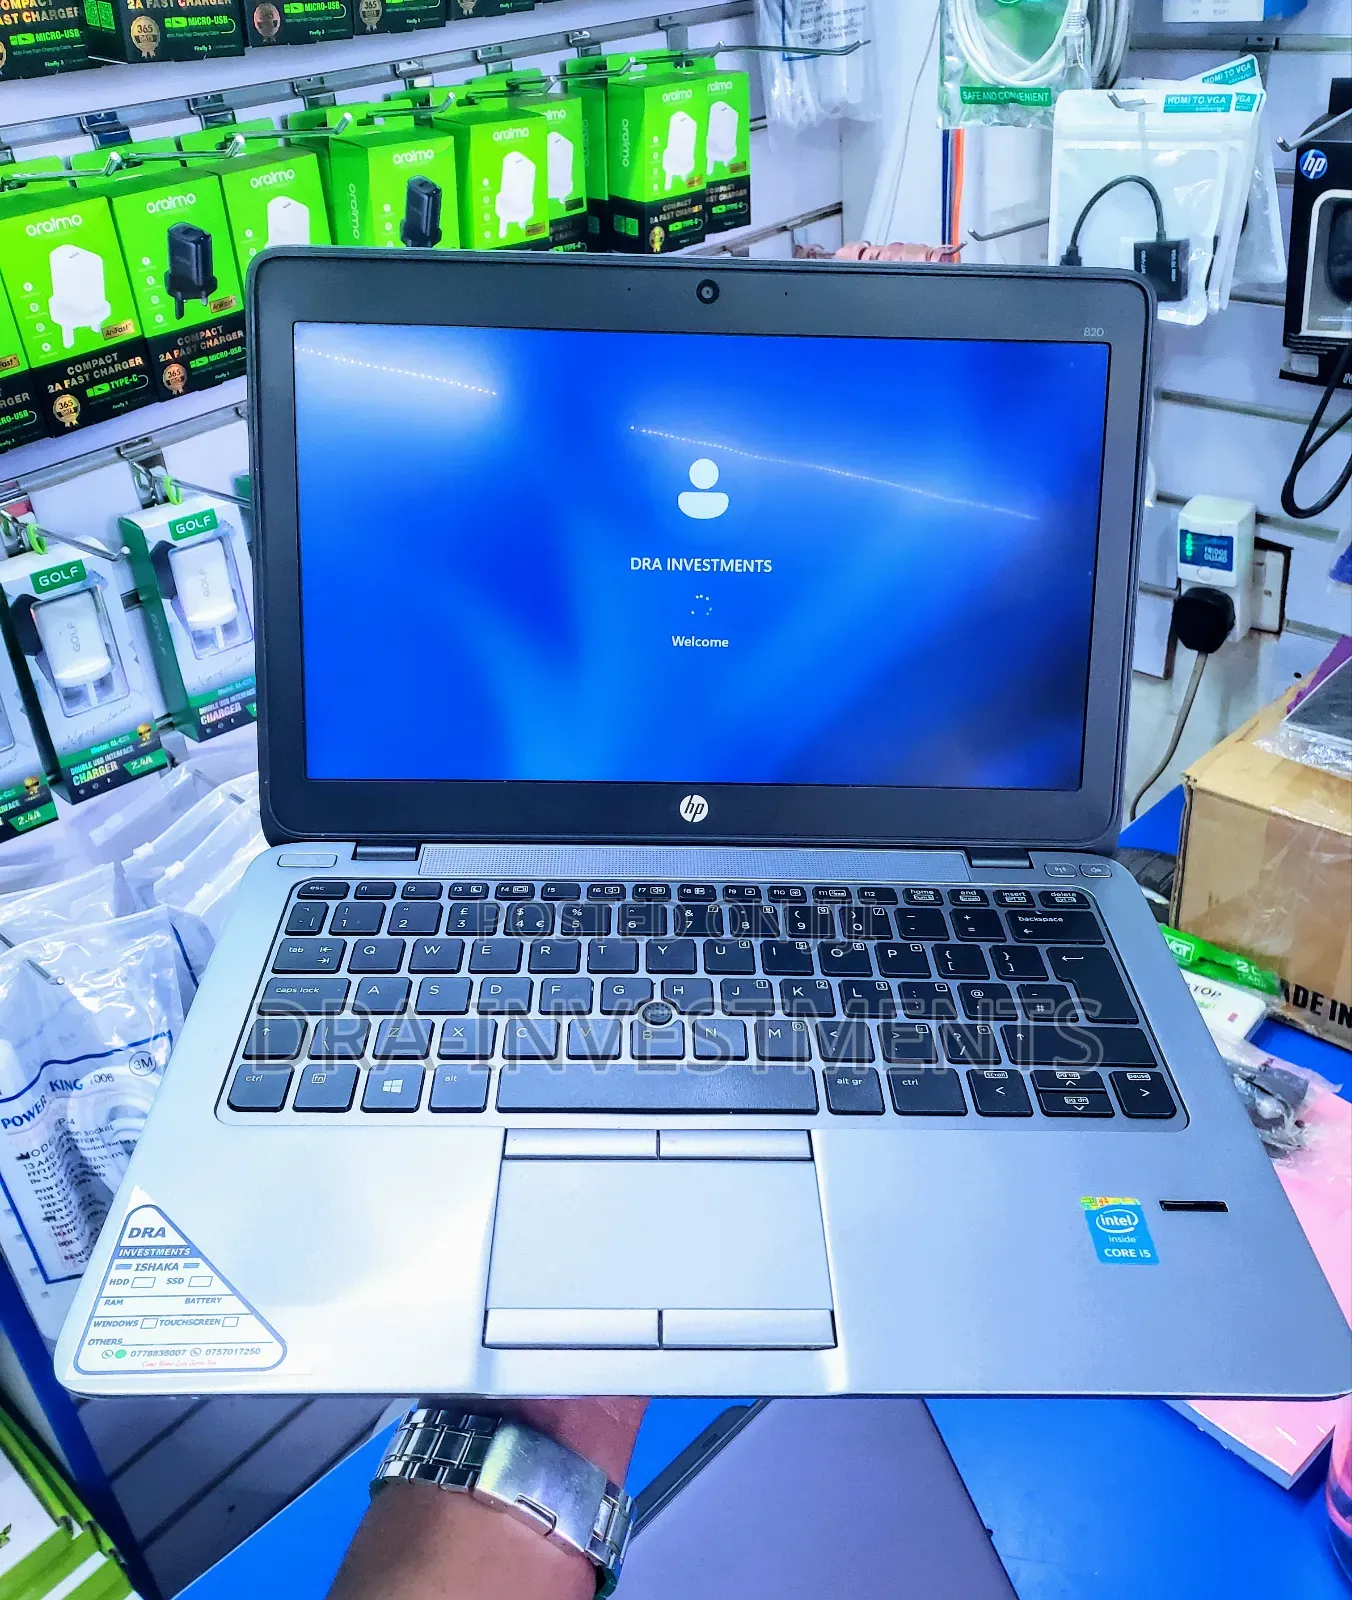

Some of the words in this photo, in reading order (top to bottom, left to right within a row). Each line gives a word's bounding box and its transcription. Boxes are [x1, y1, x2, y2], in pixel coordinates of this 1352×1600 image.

[305, 1, 340, 12] MICRO-USB
[188, 15, 229, 26] MICRO-USB
[136, 24, 153, 34] 365
[35, 29, 80, 42] MICRO-USB
[1236, 62, 1251, 74] VGA
[662, 88, 692, 103] oraimo
[962, 91, 981, 100] SAFE
[983, 91, 997, 100] AND
[997, 91, 1050, 102] CONVENIENT
[493, 127, 529, 141] oraimo
[622, 119, 630, 167] oraimo
[393, 149, 434, 165] oraimo
[1302, 149, 1327, 179] hp
[250, 169, 295, 189] oraimo
[146, 193, 196, 214] oraimo
[349, 183, 361, 239] oraimo
[26, 214, 82, 237] oraimo
[177, 325, 223, 347] COMPACT
[1083, 327, 1105, 337] 820
[159, 351, 173, 362] 2A
[173, 344, 198, 360] FAST
[199, 330, 244, 350] CHARGER
[208, 346, 242, 362] MICRO-USB
[66, 352, 119, 376] COMPACT
[47, 382, 63, 394] 2A
[63, 373, 91, 389] FAST
[92, 356, 144, 379] CHARGER
[168, 369, 181, 379] 365
[110, 374, 138, 390] TYPE-C
[58, 399, 74, 410] 365
[175, 515, 212, 534] GOLF
[630, 557, 663, 571] DRA
[667, 557, 773, 573] INVESTMENTS
[38, 566, 79, 587] GOLF
[67, 622, 81, 652] GOLF
[671, 635, 729, 648] Welcome
[200, 702, 242, 726] CHARGER
[72, 760, 118, 787] CHARGER
[681, 794, 706, 822] hp
[363, 945, 376, 957] Q
[424, 945, 441, 954] W
[481, 945, 492, 955] E
[540, 945, 551, 955] R
[597, 945, 608, 955] T
[657, 945, 668, 955] Y
[716, 945, 726, 955] U
[831, 948, 844, 957] O
[887, 949, 898, 958] P
[1237, 960, 1250, 973] 2
[276, 986, 298, 994] caps
[368, 985, 380, 995] A
[429, 985, 440, 995] S
[490, 985, 502, 995] D
[551, 985, 561, 995] F
[613, 985, 625, 995] G
[673, 985, 684, 995] H
[732, 986, 740, 996] J
[792, 986, 804, 996] K
[853, 987, 863, 998] L
[1329, 999, 1352, 1028] IN
[388, 1027, 401, 1038] Z
[452, 1027, 465, 1037] X
[516, 1027, 528, 1038] C
[579, 1027, 592, 1037] V
[642, 1030, 653, 1040] B
[705, 1027, 717, 1038] N
[768, 1028, 781, 1039] M
[134, 1057, 153, 1071] 3M
[245, 1073, 264, 1082] ctrl
[313, 1074, 326, 1082] fn
[444, 1073, 457, 1082] alt
[836, 1077, 849, 1085] alt
[902, 1077, 919, 1086] ctrl
[49, 1078, 83, 1092] KING
[1, 1094, 47, 1129] POWER
[1101, 1214, 1133, 1227] intel
[128, 1227, 166, 1239] DRA
[1108, 1235, 1137, 1243] inside
[118, 1247, 191, 1257] INVESTMENTS
[1104, 1248, 1138, 1258] CORE
[1139, 1248, 1151, 1258] i5
[134, 1262, 179, 1272] ISHAKA
[109, 1278, 130, 1286] HDD
[166, 1277, 185, 1285] SSD
[184, 1297, 222, 1305] BATTERY
[93, 1320, 139, 1328] WINDOWS
[159, 1318, 221, 1327] TOUCHSCREEN
[87, 1338, 123, 1346] OTHERS
